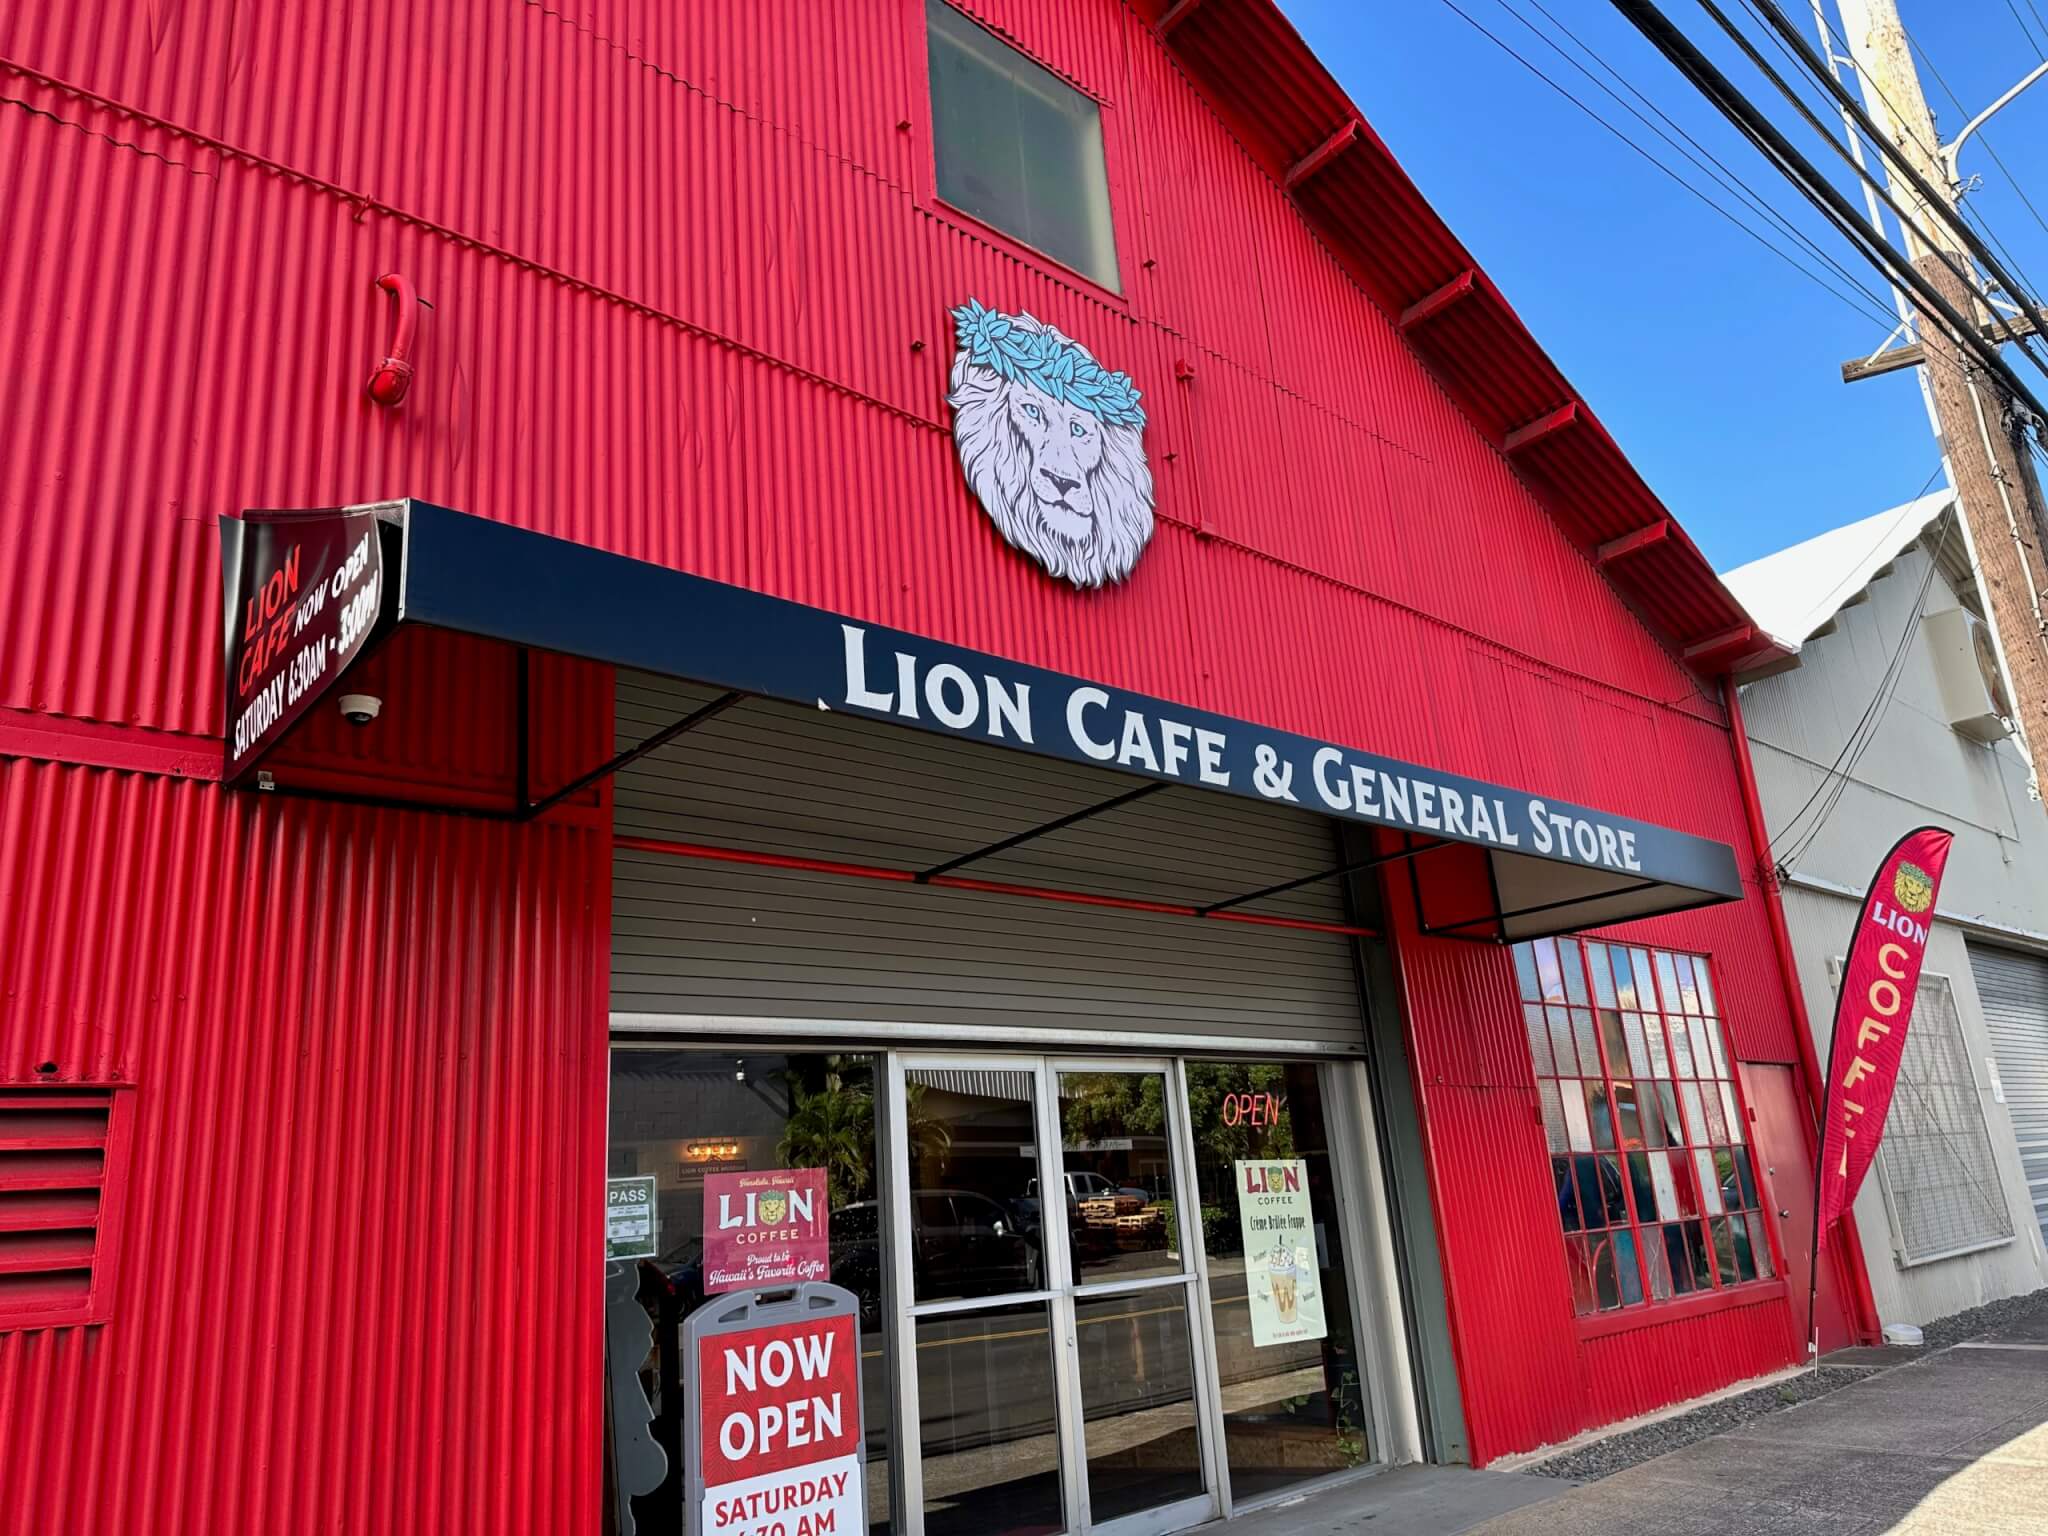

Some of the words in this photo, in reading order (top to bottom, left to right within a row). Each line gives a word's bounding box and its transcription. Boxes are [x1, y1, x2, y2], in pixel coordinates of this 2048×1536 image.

[244, 543, 301, 642] LION
[294, 578, 329, 637] NOW
[331, 531, 369, 598] OPEN
[239, 601, 297, 696] CAFE
[233, 670, 286, 760] SATURDAY
[288, 634, 326, 706] 6:30AM
[840, 623, 1034, 745] LION
[1066, 686, 1231, 787] CAFE
[1252, 743, 1300, 803] &
[1312, 747, 1519, 846] GENERAL
[1528, 799, 1641, 872] STORE
[1872, 901, 1927, 946] LION
[1838, 942, 1910, 1177] COFFE
[1223, 1092, 1280, 1127] OPEN
[609, 1189, 647, 1203] PASS
[1257, 1196, 1294, 1205] COFFEE
[736, 1229, 799, 1245] COFFEE
[747, 1253, 772, 1266] Proud
[774, 1252, 781, 1262] to
[709, 1267, 754, 1286] Hawaii's
[757, 1263, 795, 1280] Favorite
[797, 1260, 824, 1279] Coffee
[723, 1331, 836, 1396] NOW
[719, 1392, 843, 1461] OPEN
[715, 1471, 848, 1528] SATURDAY
[797, 1508, 835, 1536] AM
